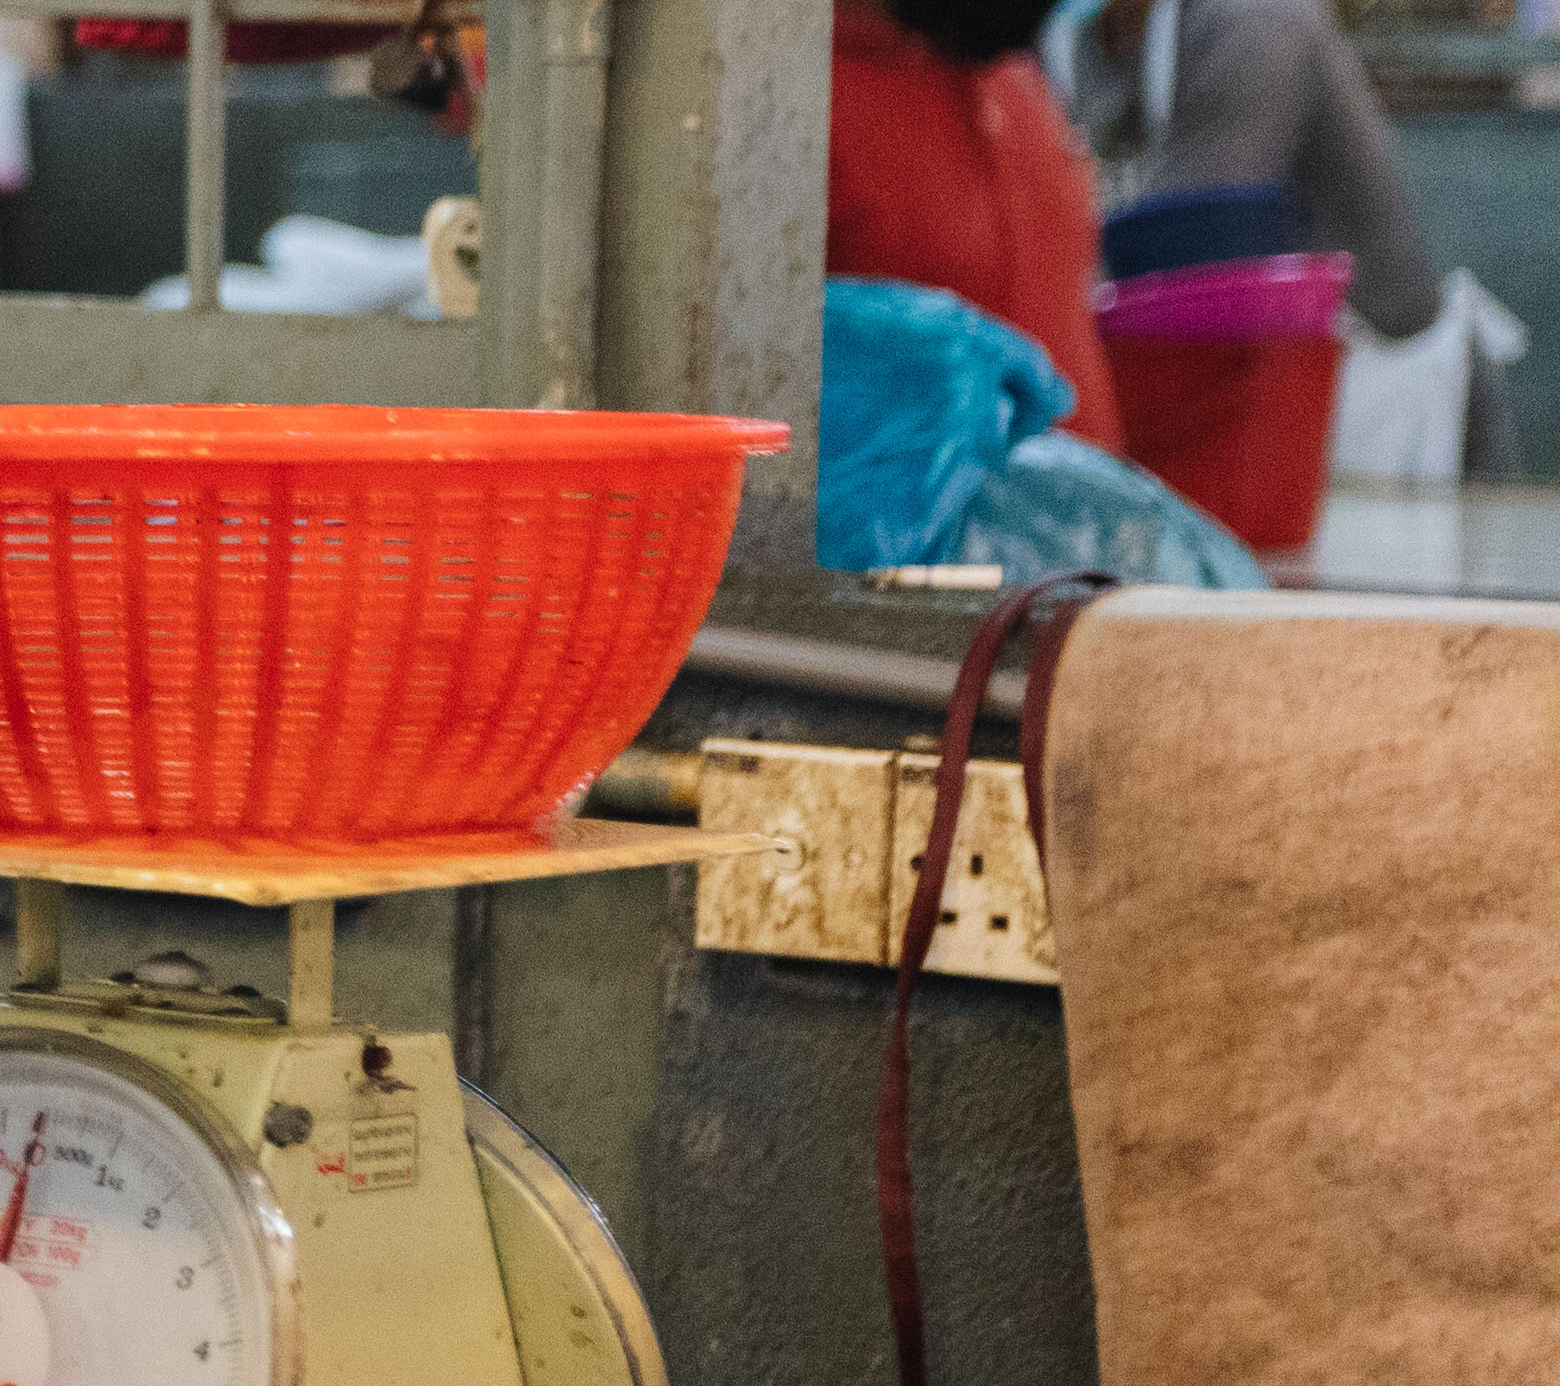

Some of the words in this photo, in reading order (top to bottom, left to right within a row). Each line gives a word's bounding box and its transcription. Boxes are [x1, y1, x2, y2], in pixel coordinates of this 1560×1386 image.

[142, 1206, 162, 1230] 2
[176, 1266, 195, 1290] 3
[193, 1340, 211, 1361] 4
